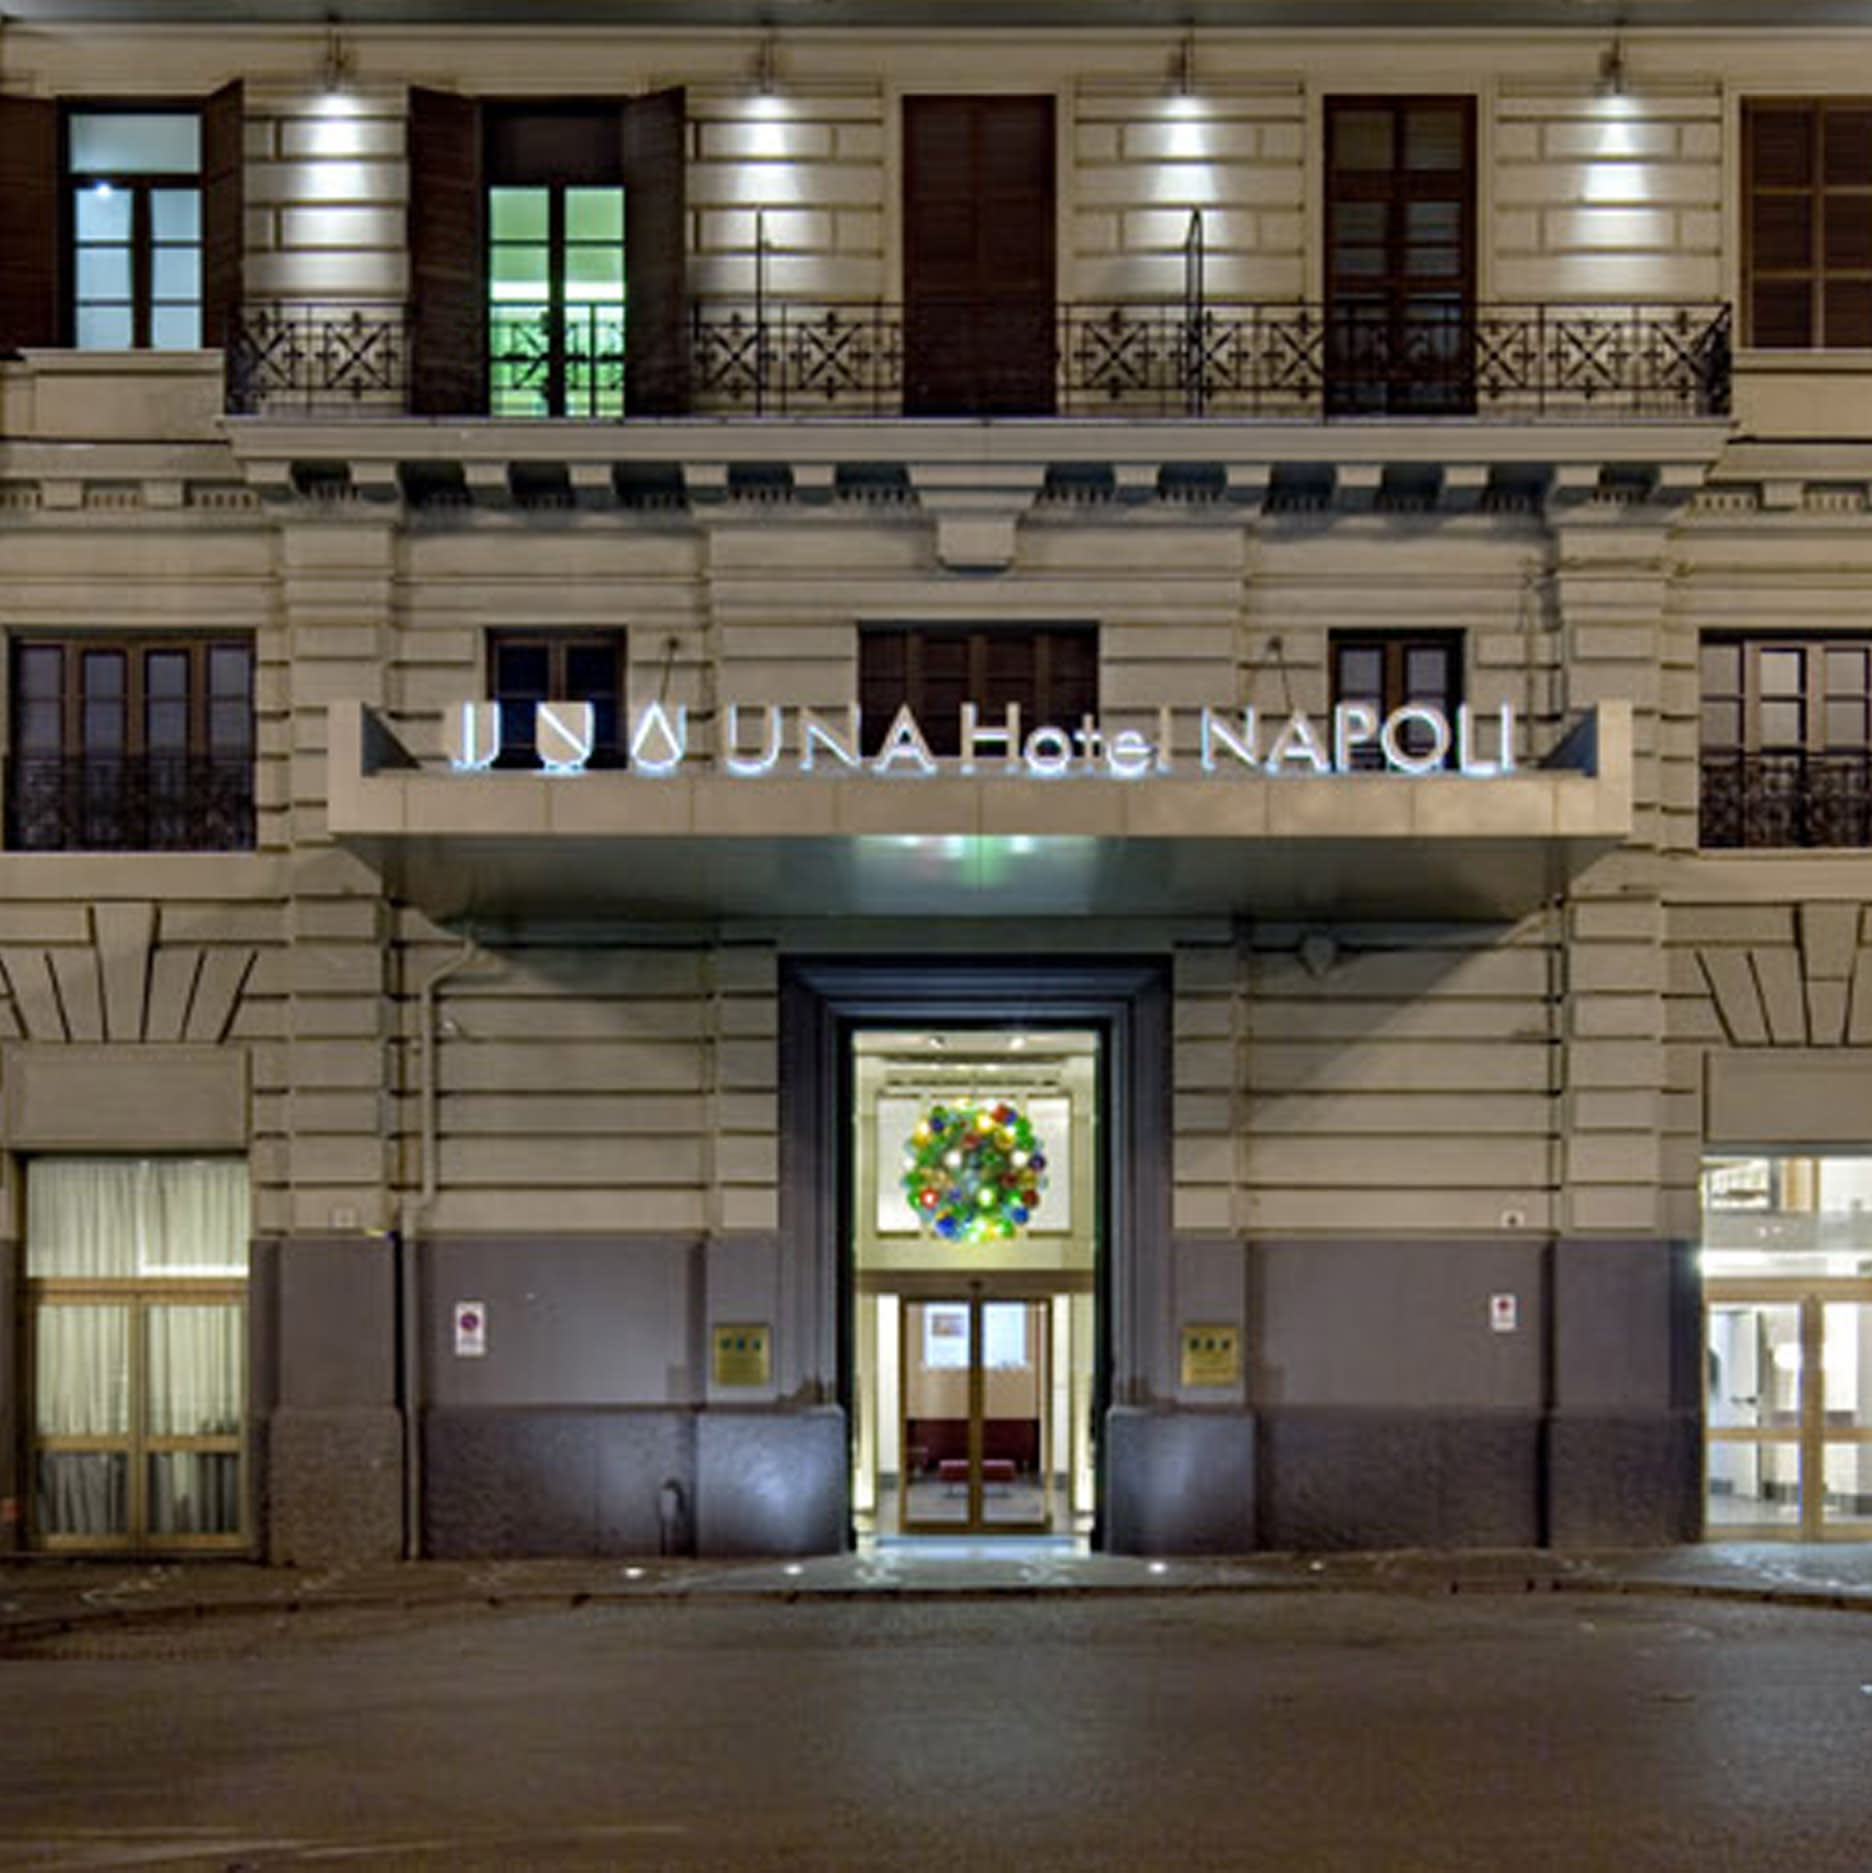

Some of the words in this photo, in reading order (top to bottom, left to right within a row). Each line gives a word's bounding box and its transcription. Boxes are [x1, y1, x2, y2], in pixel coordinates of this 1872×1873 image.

[727, 702, 938, 774] UNA
[959, 701, 1173, 774] Hotel
[1200, 701, 1516, 775] NAPOLI
